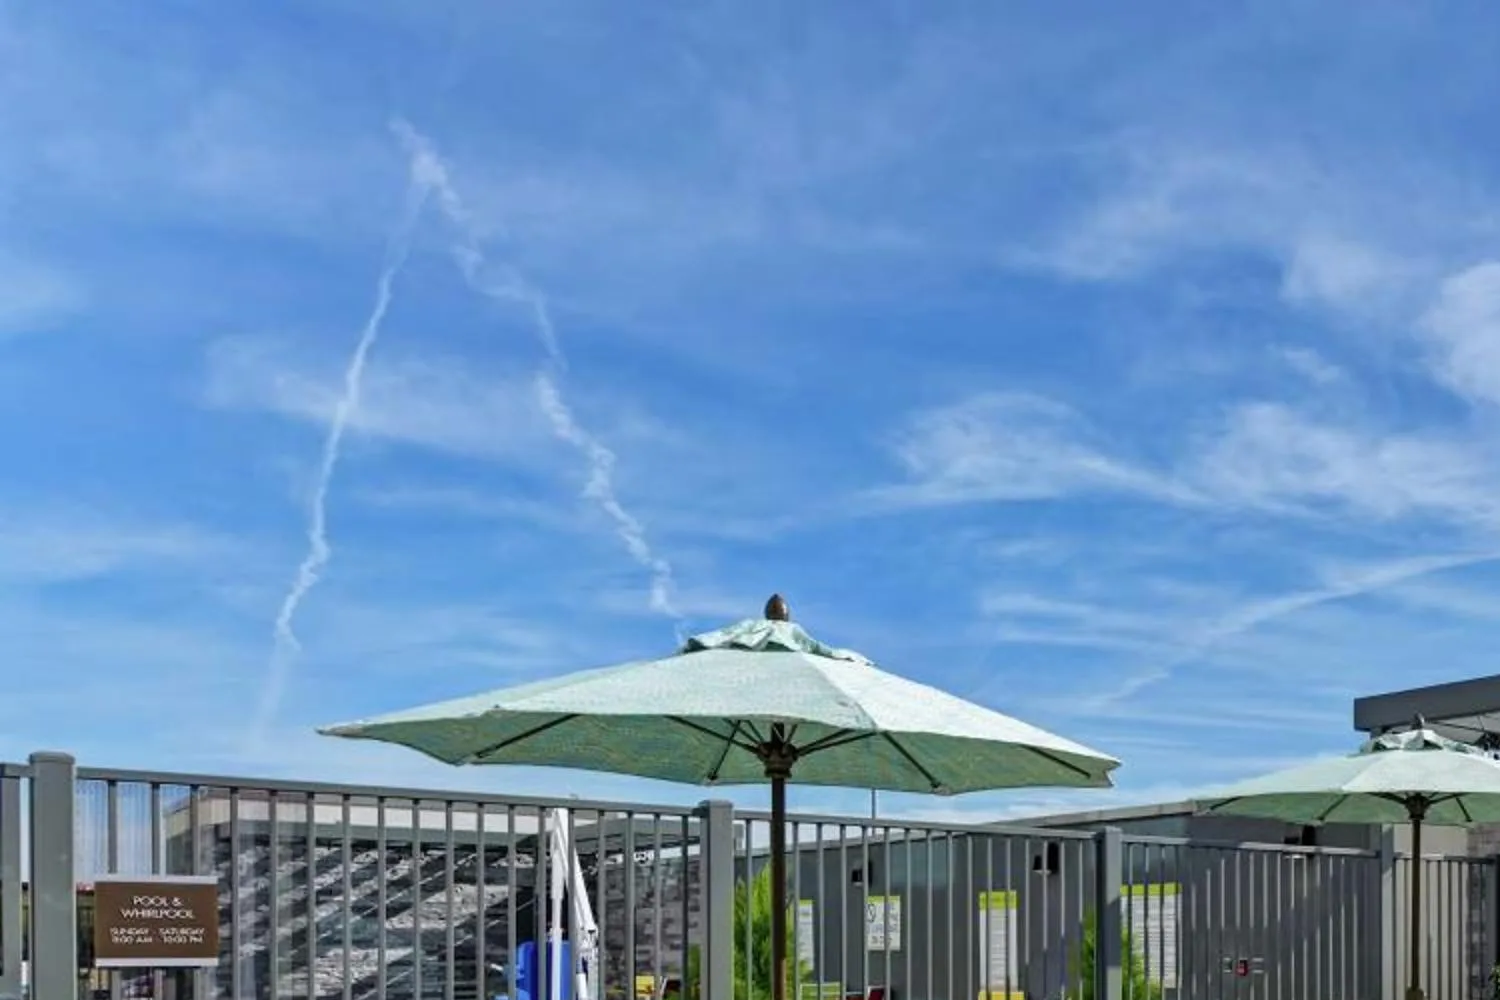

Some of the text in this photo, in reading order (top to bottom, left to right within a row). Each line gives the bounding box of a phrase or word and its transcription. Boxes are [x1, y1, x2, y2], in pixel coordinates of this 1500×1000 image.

[133, 895, 183, 906] POOL &
[121, 908, 195, 919] WHIRLPOOL
